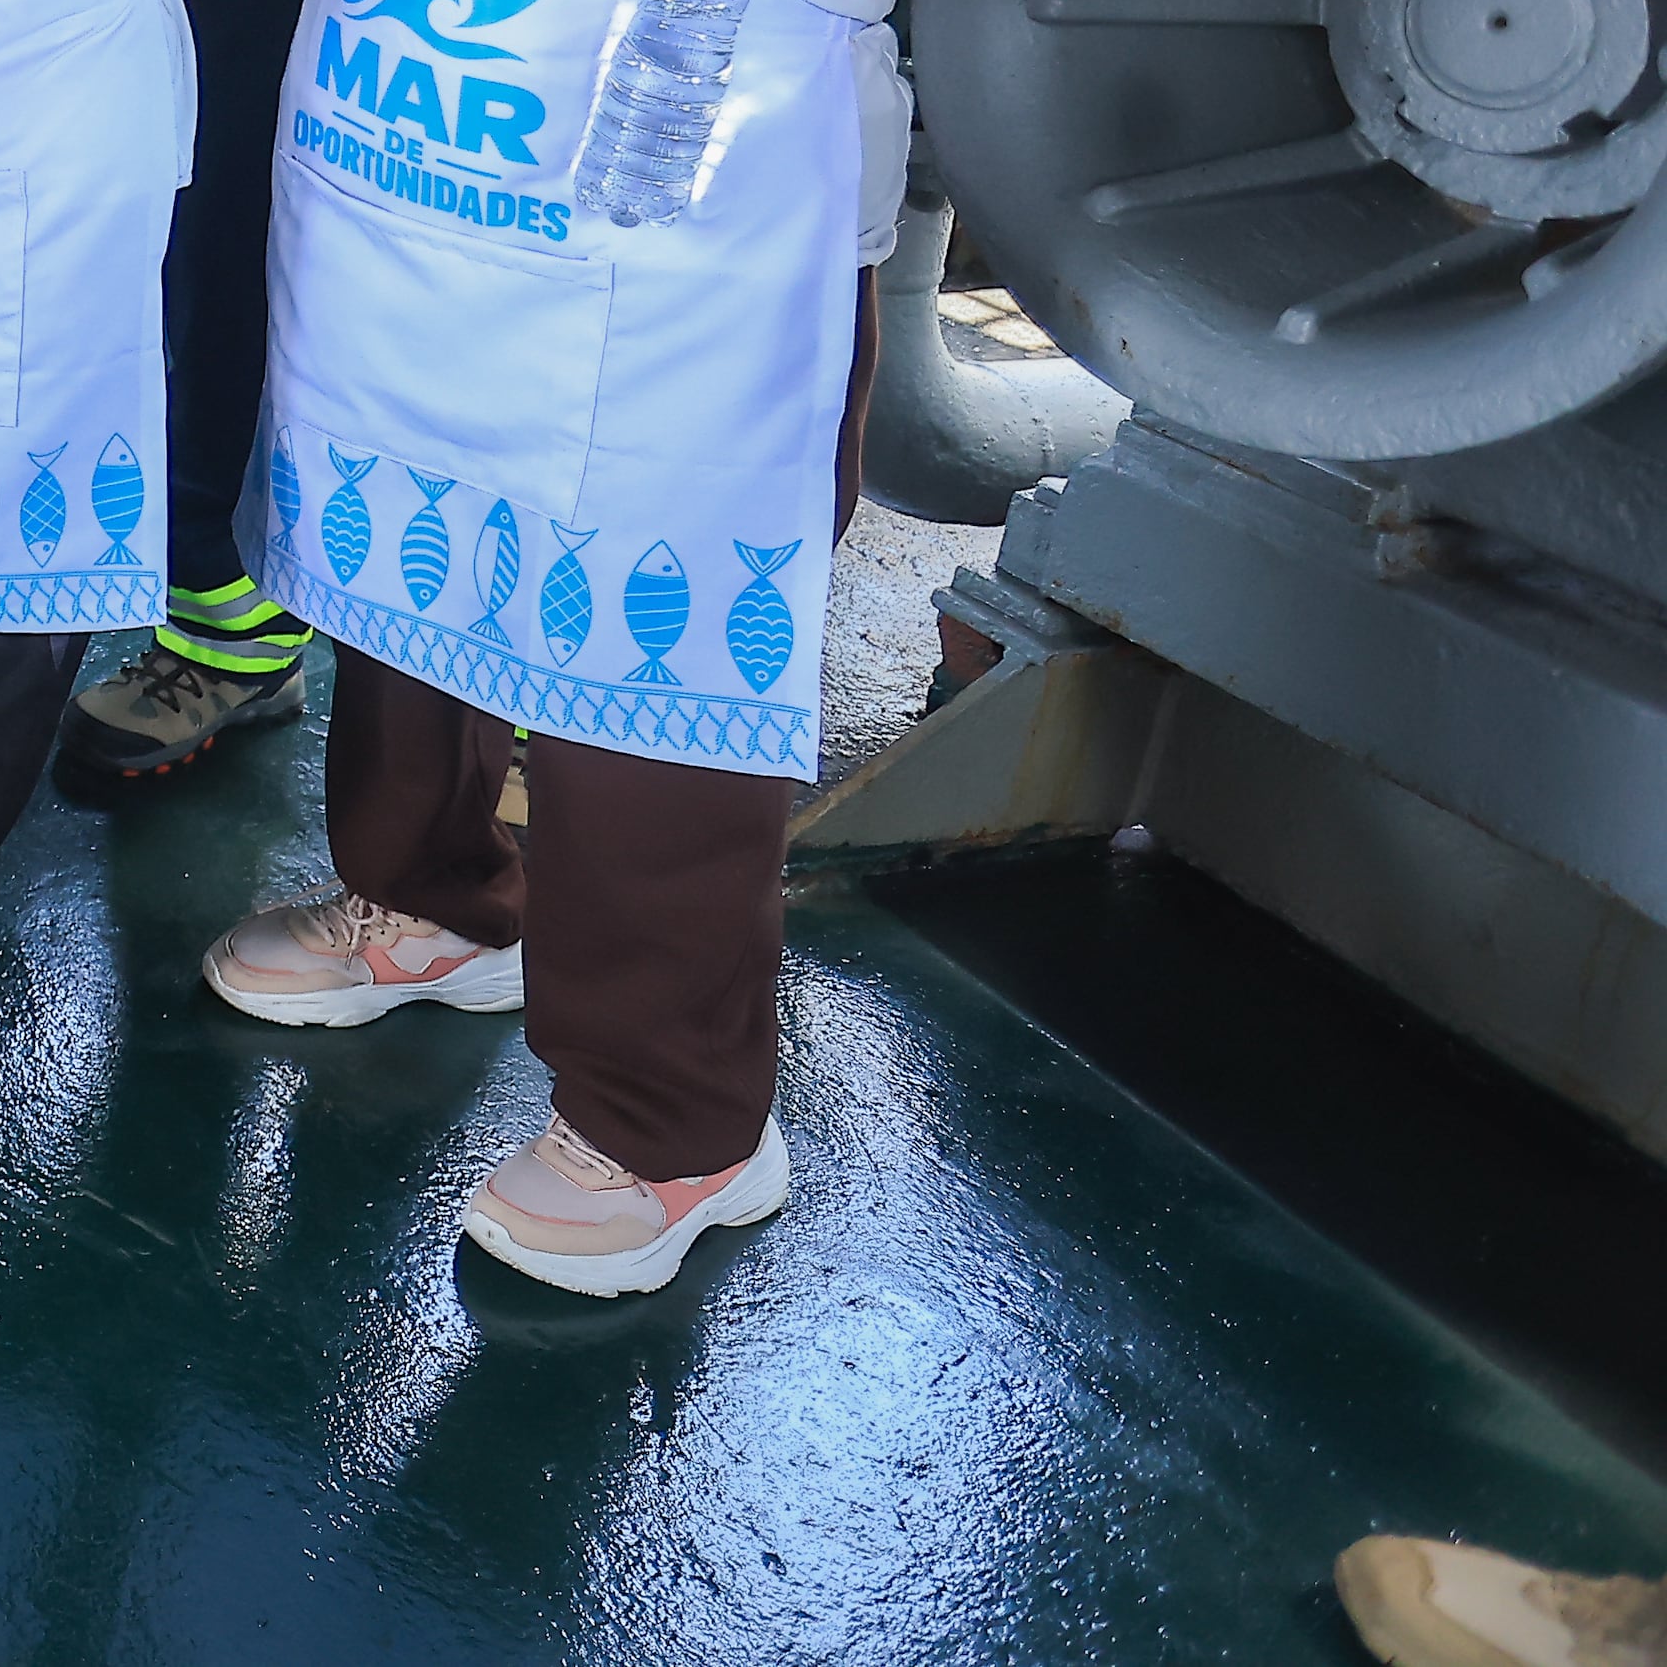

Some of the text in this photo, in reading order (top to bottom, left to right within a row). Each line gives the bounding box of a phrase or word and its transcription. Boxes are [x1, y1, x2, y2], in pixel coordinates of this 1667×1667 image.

[316, 15, 546, 166] MAR
[384, 128, 424, 165] DE
[294, 109, 571, 242] OPORTUNIDADES
